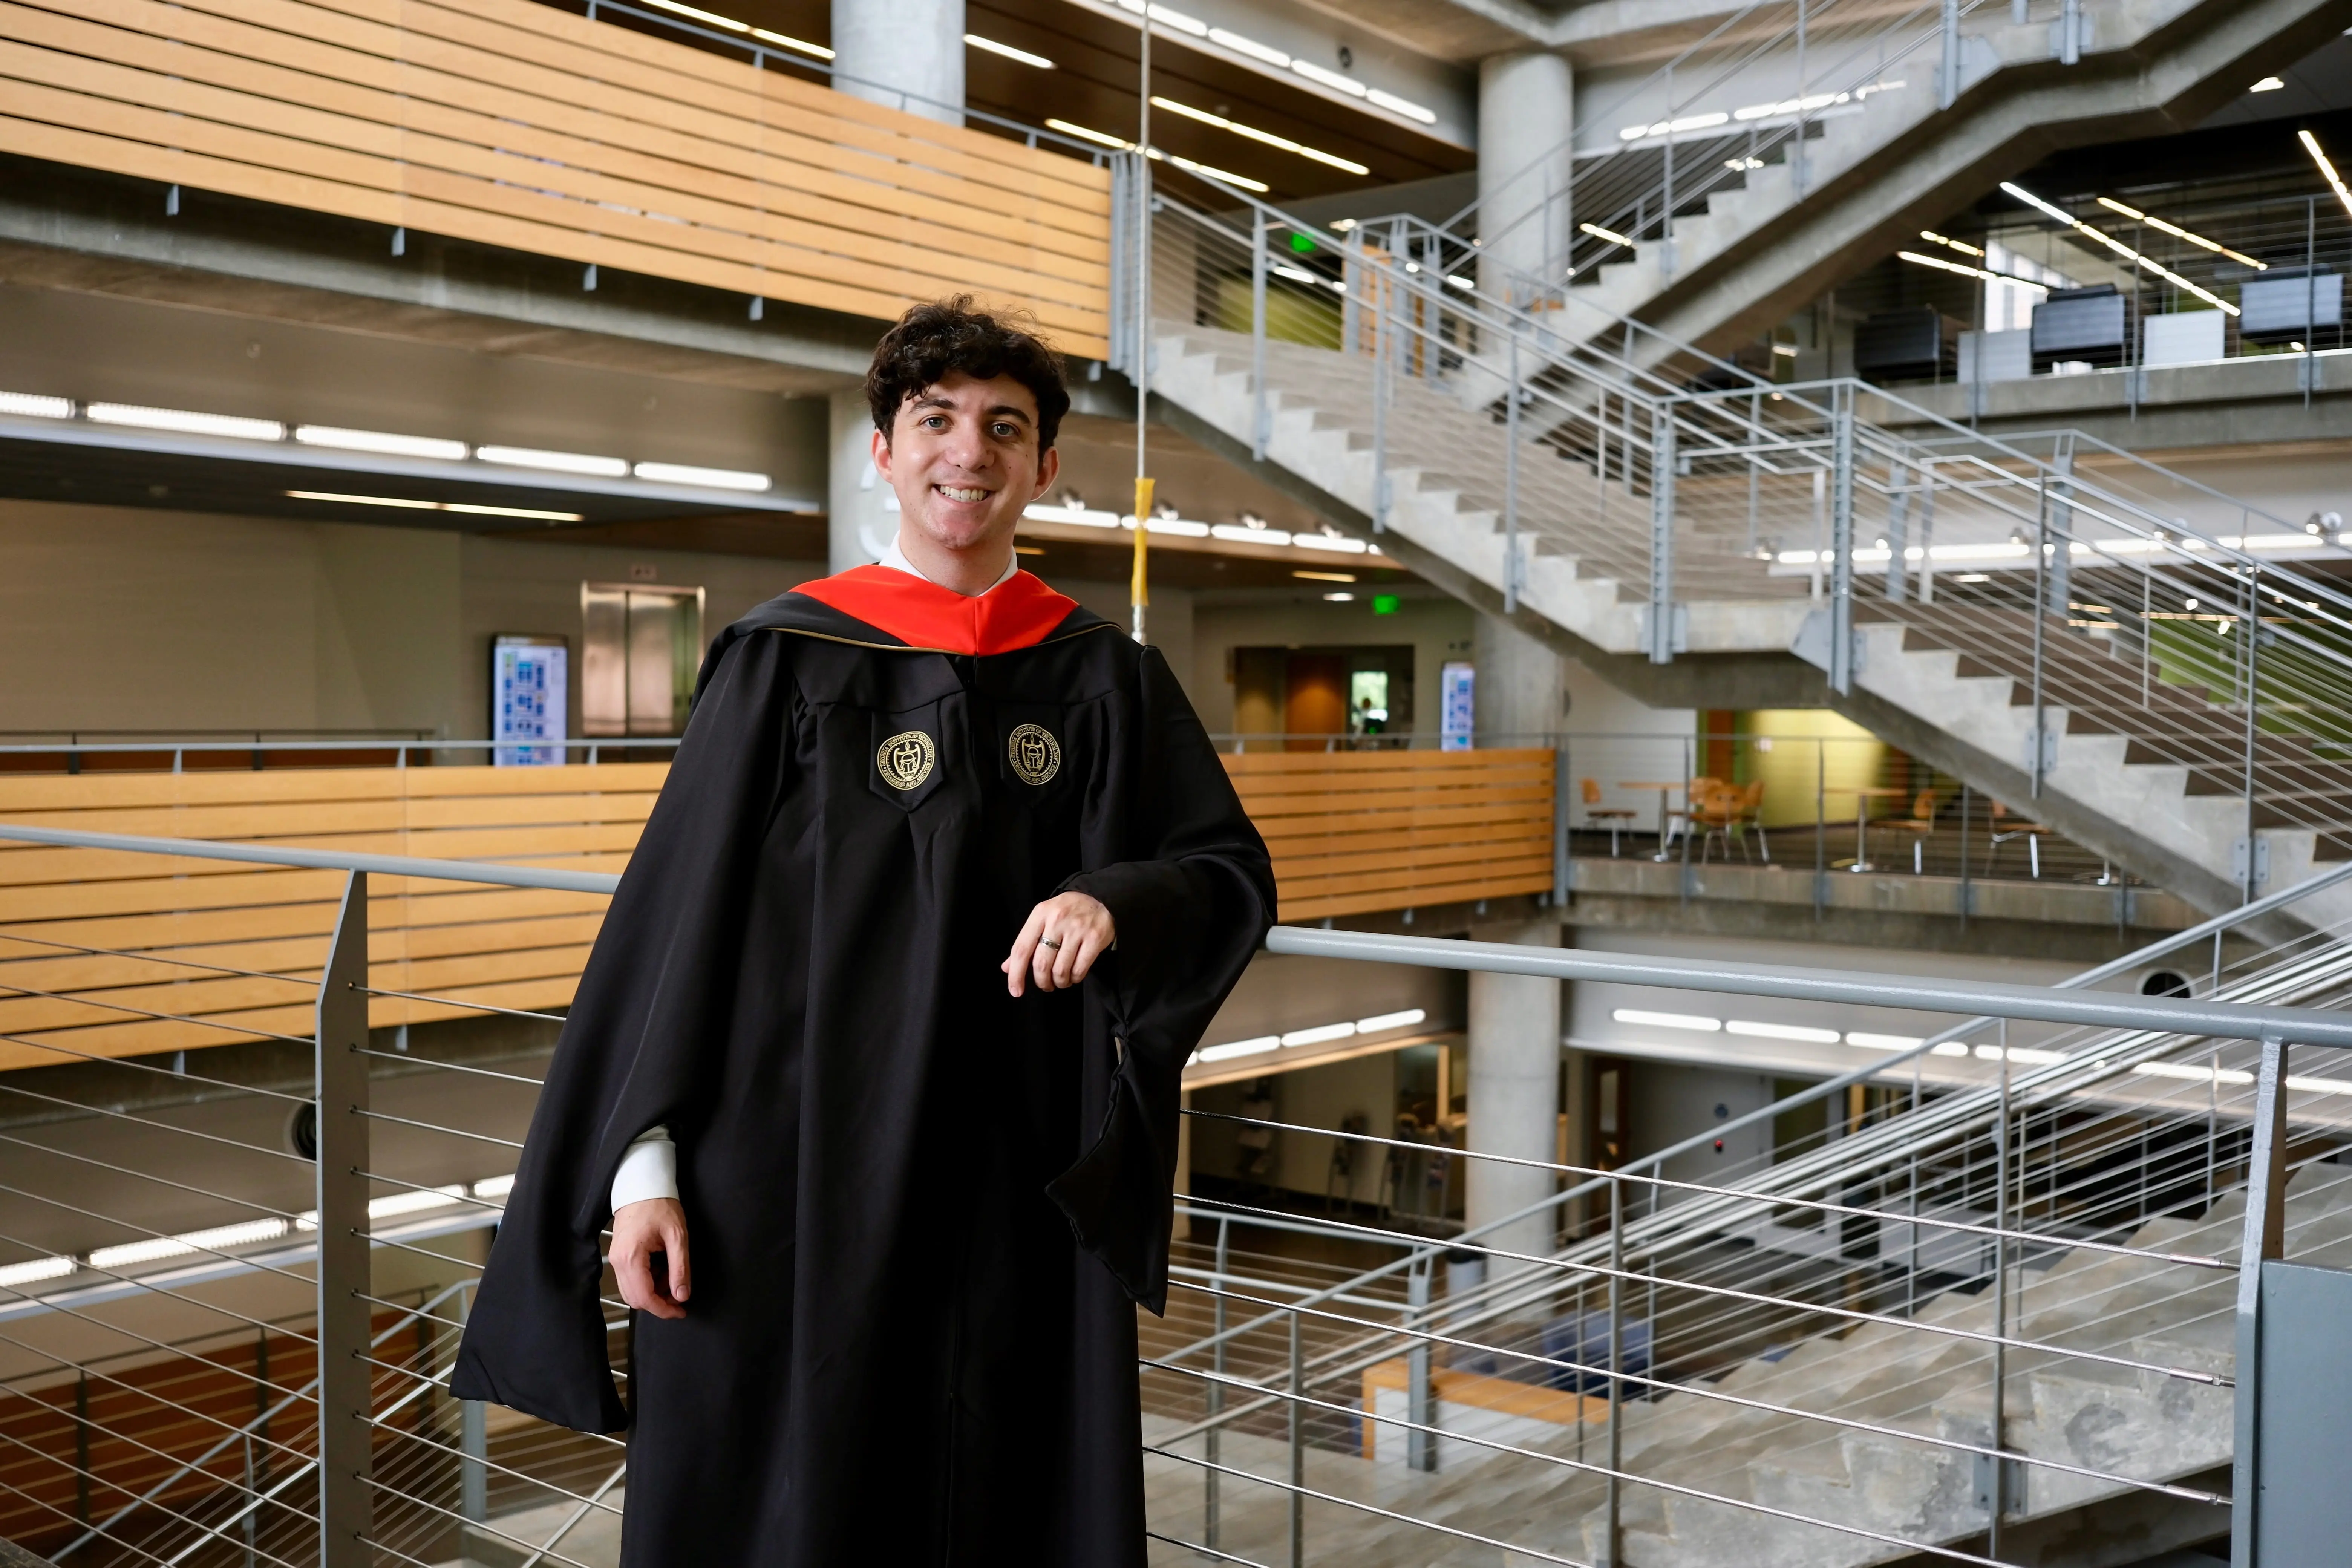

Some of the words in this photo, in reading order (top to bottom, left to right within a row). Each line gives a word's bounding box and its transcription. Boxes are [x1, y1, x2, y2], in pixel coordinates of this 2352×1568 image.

[880, 747, 889, 766] GEORGIA
[888, 735, 911, 747] INSTITUTE
[1015, 727, 1035, 737] INSTITUTE
[1042, 732, 1058, 761] TECHNOLOGY
[883, 769, 905, 787] PROGRESS
[917, 762, 932, 782] SERVICE
[1041, 764, 1056, 780] SERVICE
